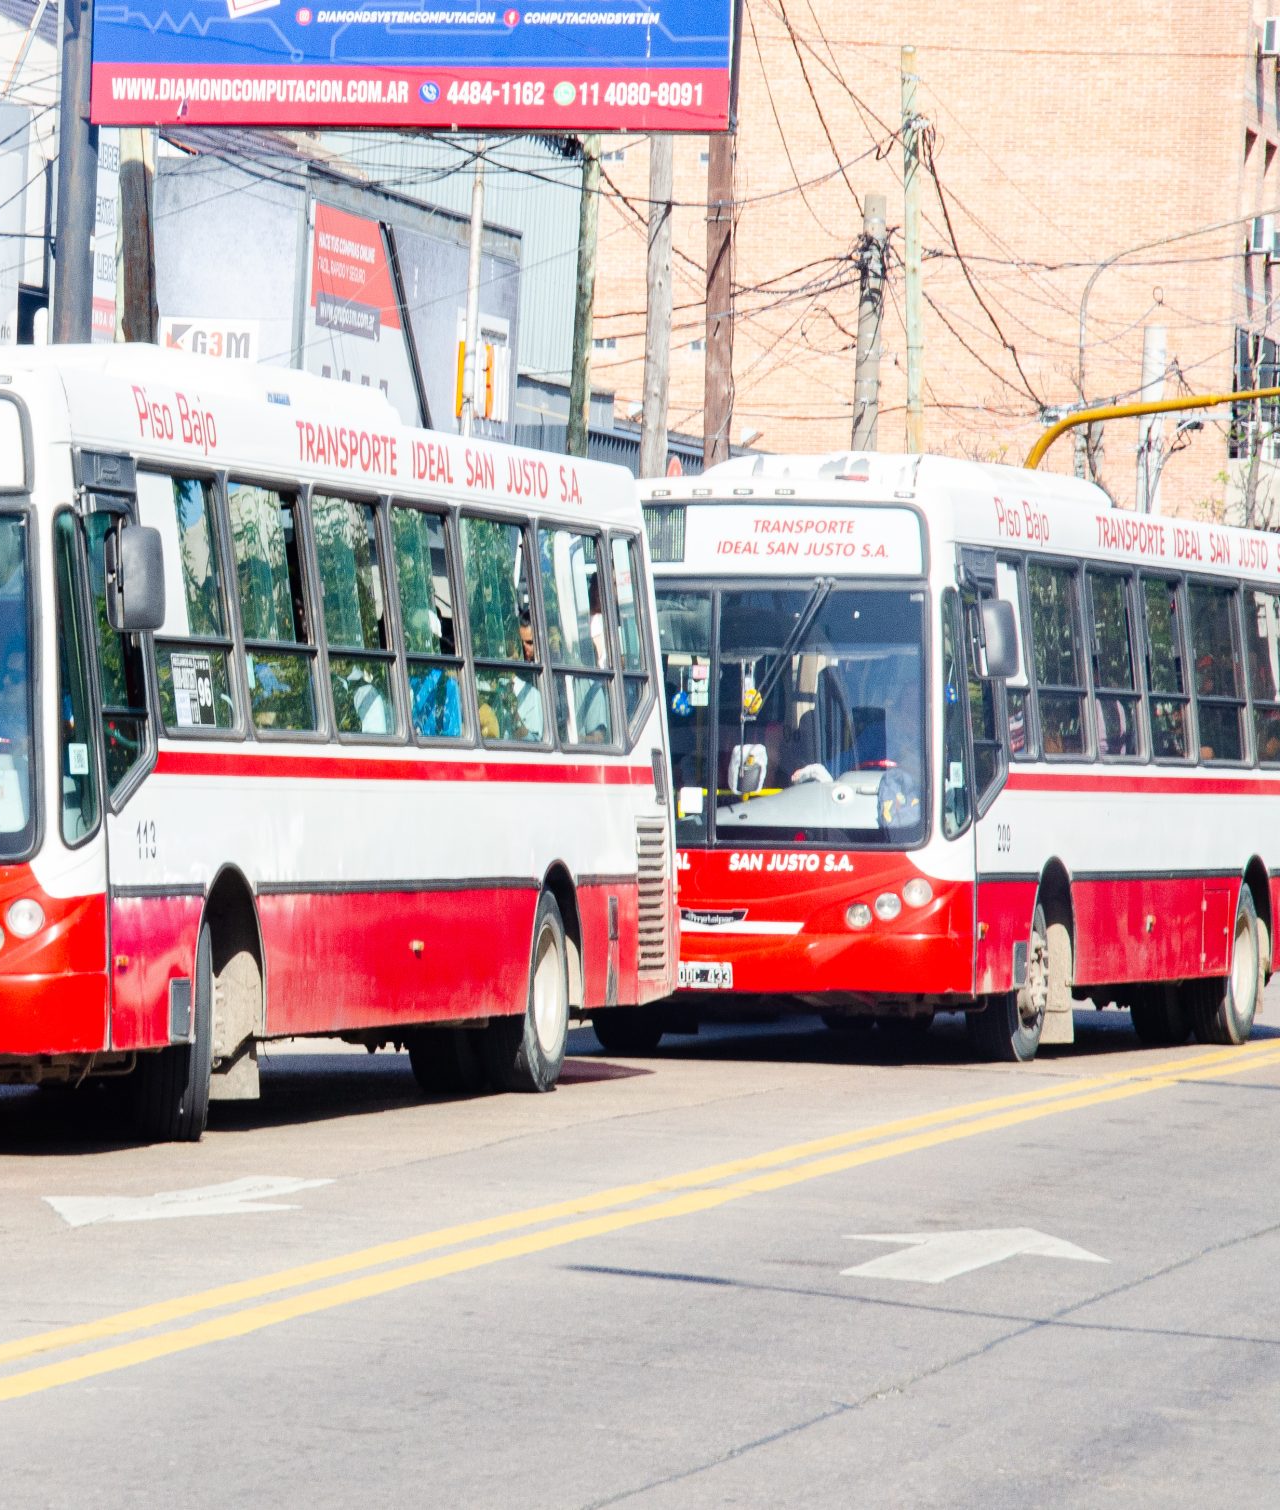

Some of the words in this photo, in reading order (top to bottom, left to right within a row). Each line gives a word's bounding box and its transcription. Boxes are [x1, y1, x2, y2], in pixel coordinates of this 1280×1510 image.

[317, 10, 495, 24] DIAMONDSYSTEMCOMPUTACION
[524, 12, 659, 25] COMPUTACIONDSYSTEM
[111, 77, 409, 103] WWW.DIAMONDCOMPUTACION.COM.AR
[447, 81, 545, 105] 4484-1162
[579, 82, 599, 105] 11
[604, 82, 703, 106] 4080-8091
[192, 330, 250, 359] G3M
[131, 385, 174, 440] Piso
[175, 391, 217, 457] Bajo
[296, 420, 397, 476] TRANSPORTE
[412, 441, 453, 484] IDEAL
[465, 448, 495, 490] SAN
[506, 456, 548, 498] JUSTO
[559, 465, 582, 504] S.A.
[753, 520, 855, 534] TRANSPORTE
[993, 496, 1020, 538] Piso
[1022, 500, 1050, 547] Bajo
[717, 541, 759, 554] IDEAL
[766, 542, 799, 555] SAN
[804, 543, 855, 556] JUSTO
[861, 544, 889, 558] S.A.
[1095, 516, 1166, 555] TRANSPORTE
[1173, 527, 1203, 561] IDEAL
[1209, 532, 1231, 565] SAN
[1238, 538, 1269, 570] JUSTO
[197, 676, 212, 708] 96
[729, 852, 764, 871] SAN
[767, 853, 820, 872] JUSTO
[824, 854, 854, 872] S.A.
